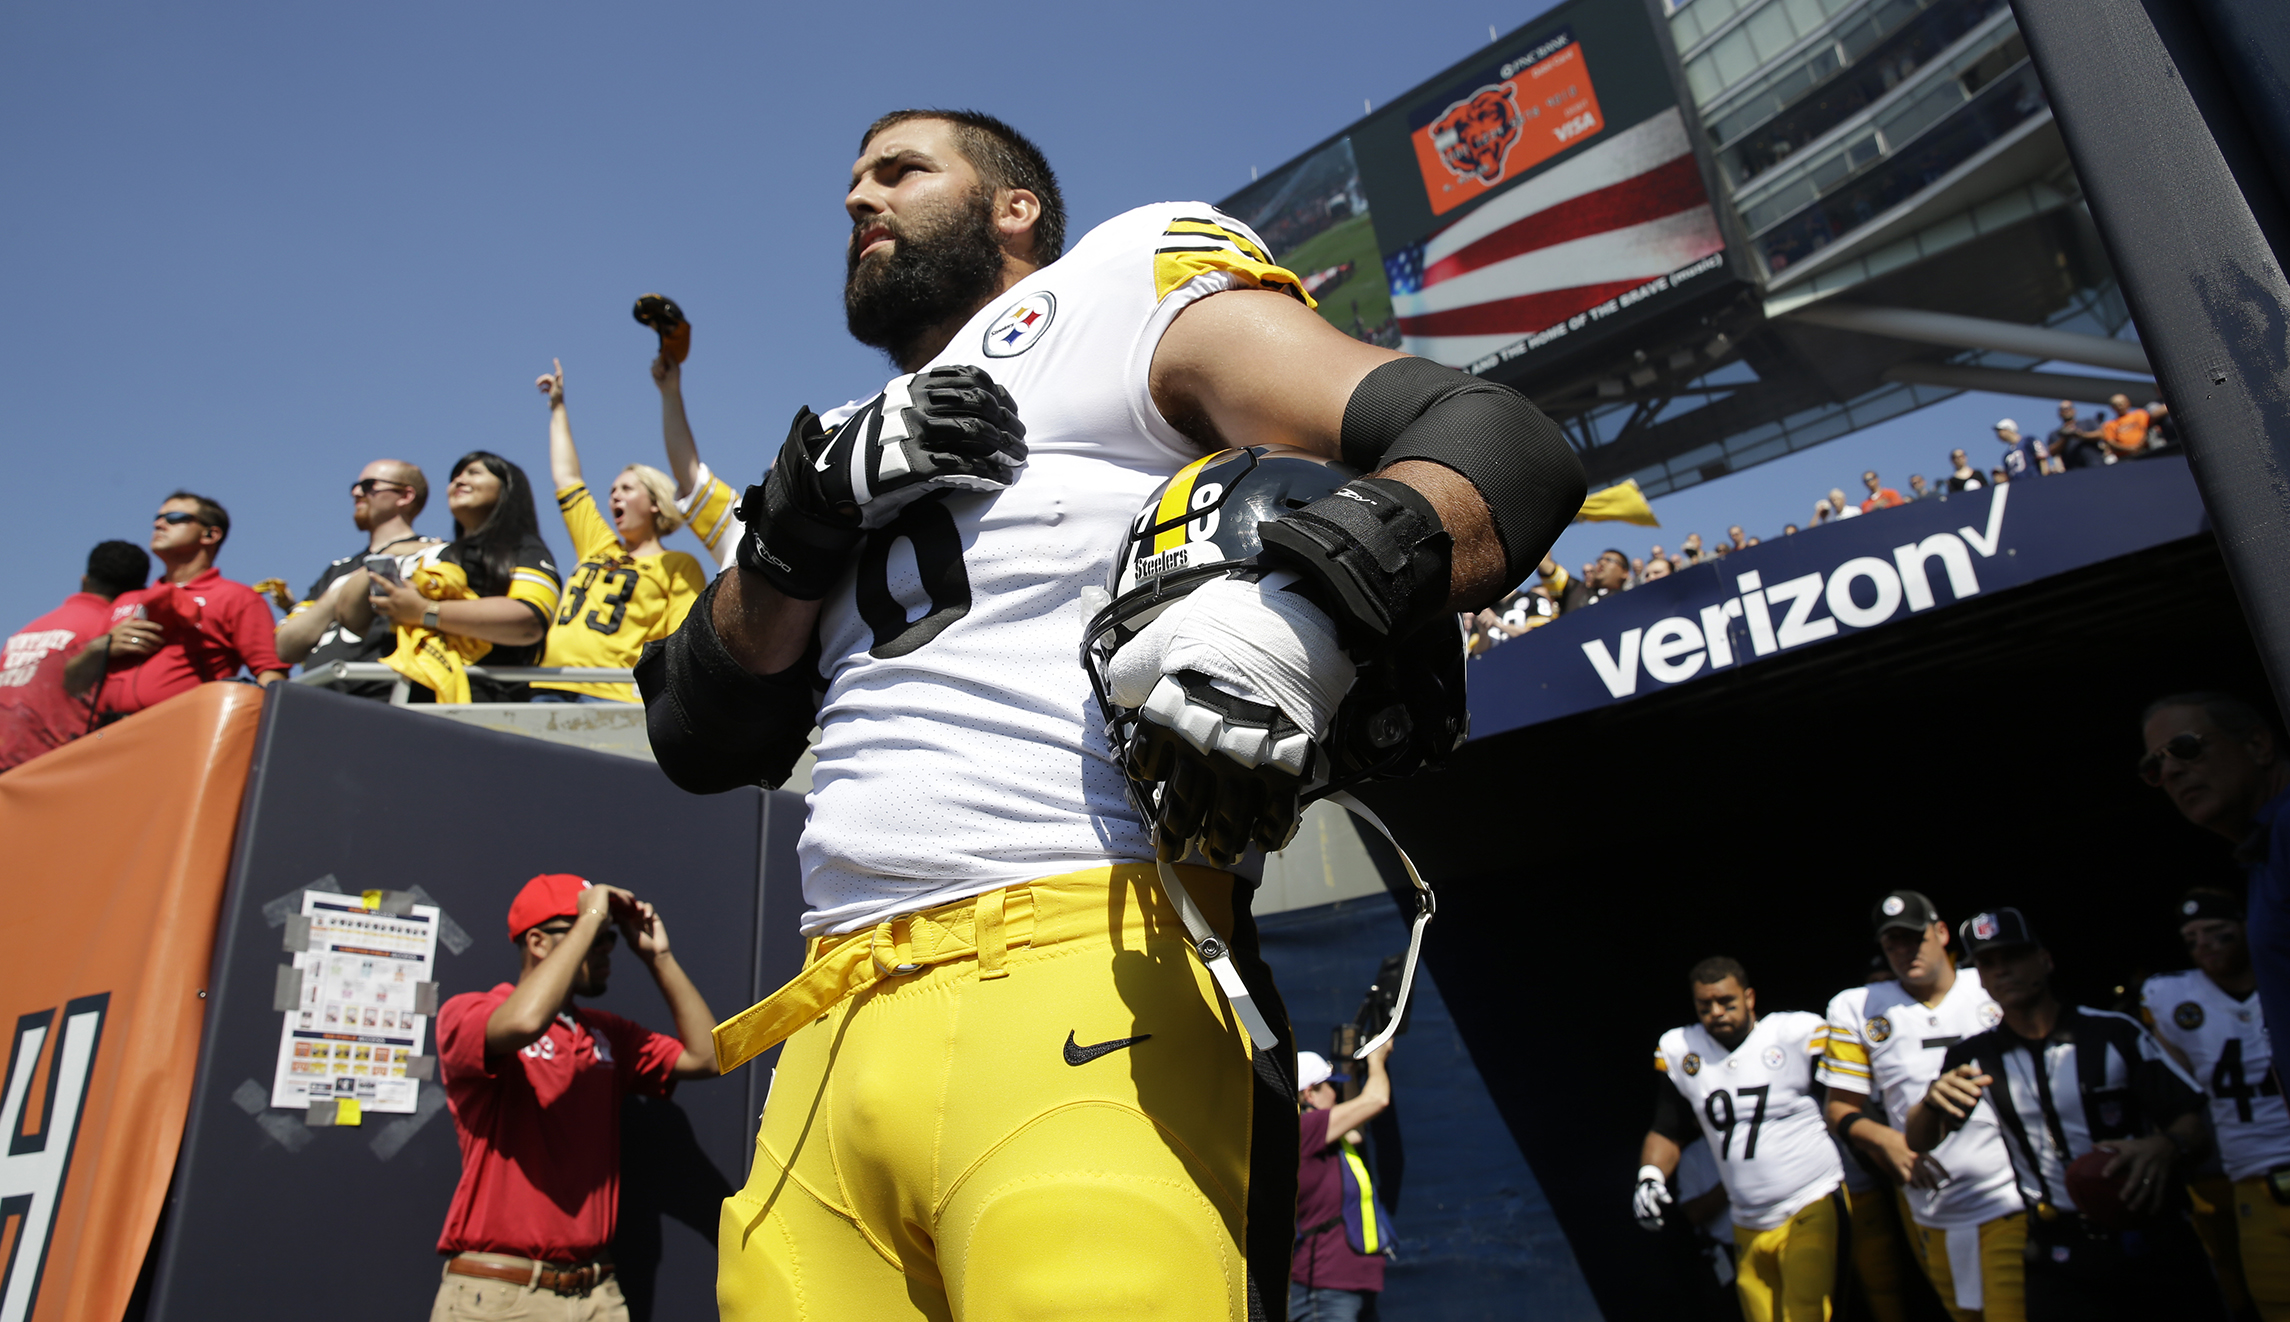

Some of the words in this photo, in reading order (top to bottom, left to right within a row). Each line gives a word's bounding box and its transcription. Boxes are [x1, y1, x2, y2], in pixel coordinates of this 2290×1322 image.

[1536, 33, 1568, 59] BANK
[1552, 111, 1597, 142] VISA
[1471, 355, 1500, 376] AND
[1500, 342, 1528, 362] THE
[1528, 322, 1568, 350] HOME
[1567, 312, 1588, 332] OF
[1588, 298, 1619, 322] THE
[1619, 276, 1669, 308] BRAVE
[1668, 252, 1723, 287] (music)
[1133, 548, 1189, 581] Steelers
[1580, 532, 1981, 699] verizon
[1704, 1083, 1770, 1161] 97
